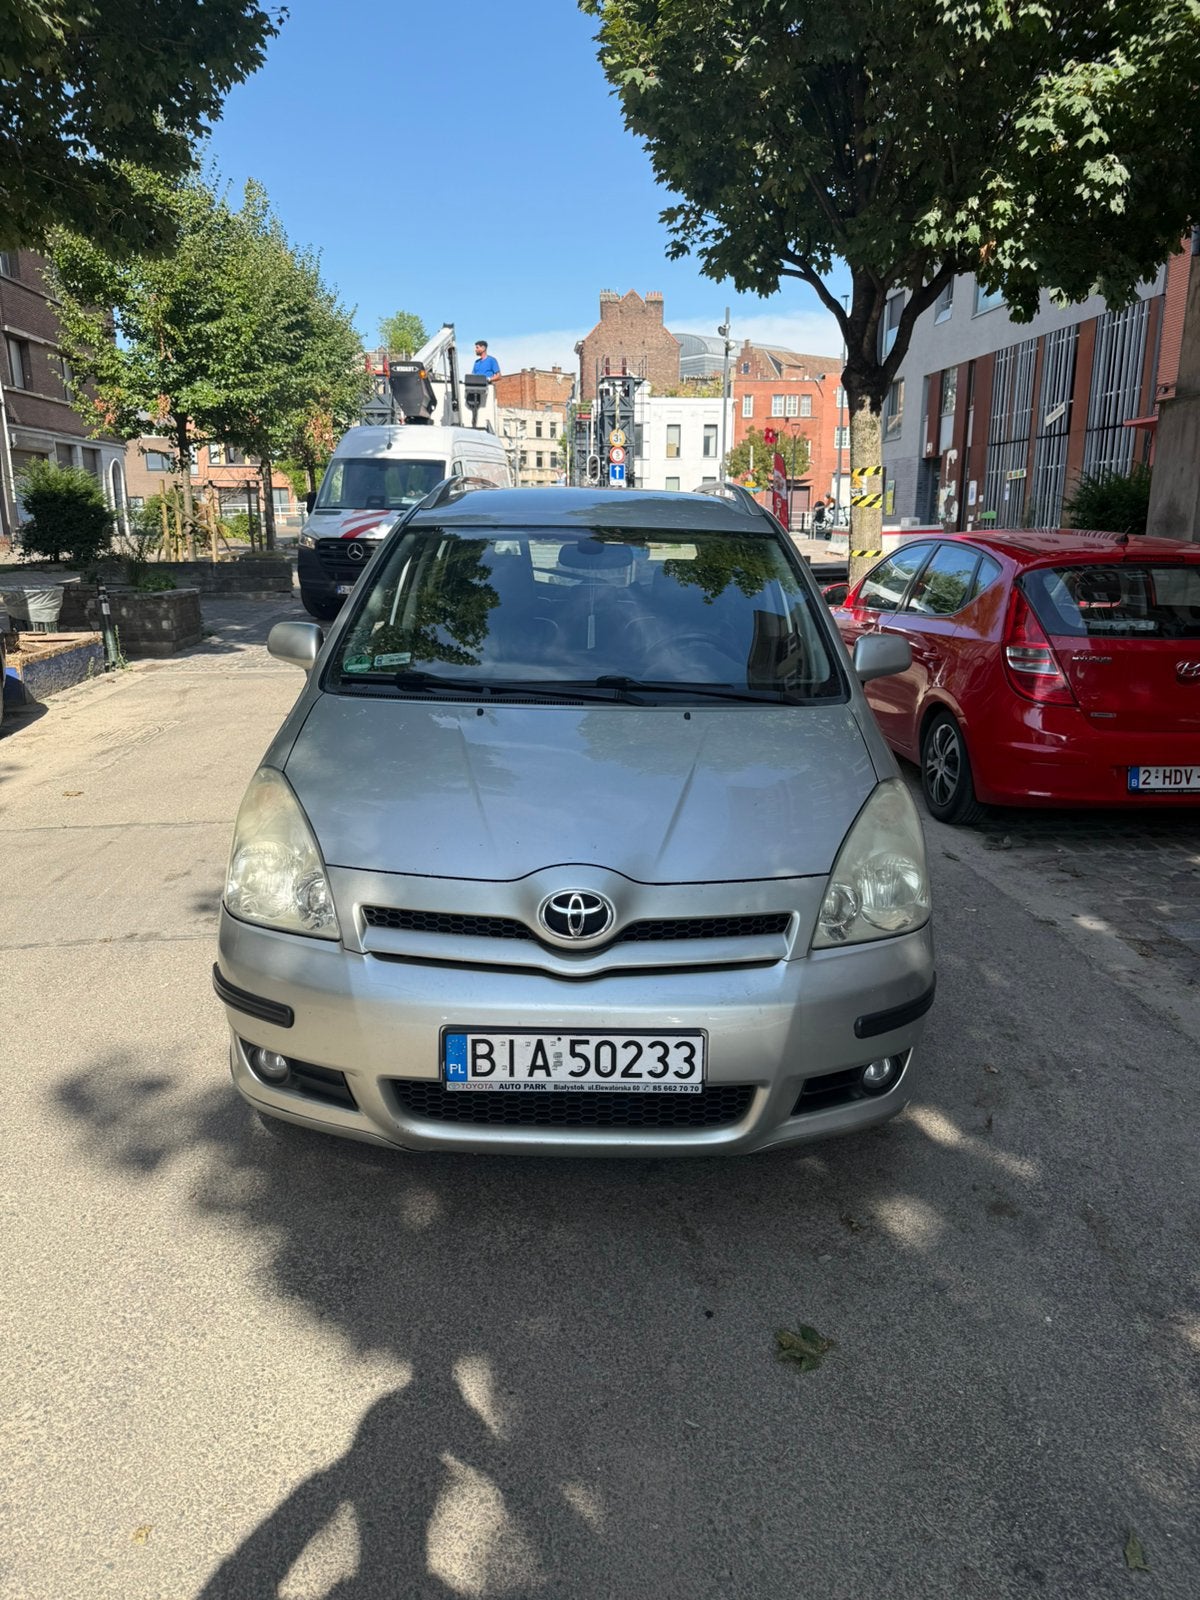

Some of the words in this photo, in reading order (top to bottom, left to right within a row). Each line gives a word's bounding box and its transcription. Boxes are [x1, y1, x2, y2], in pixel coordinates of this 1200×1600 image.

[471, 1038, 552, 1078] BIA
[568, 1038, 696, 1080] 50233
[450, 1063, 465, 1075] PL
[690, 1085, 700, 1093] 70
